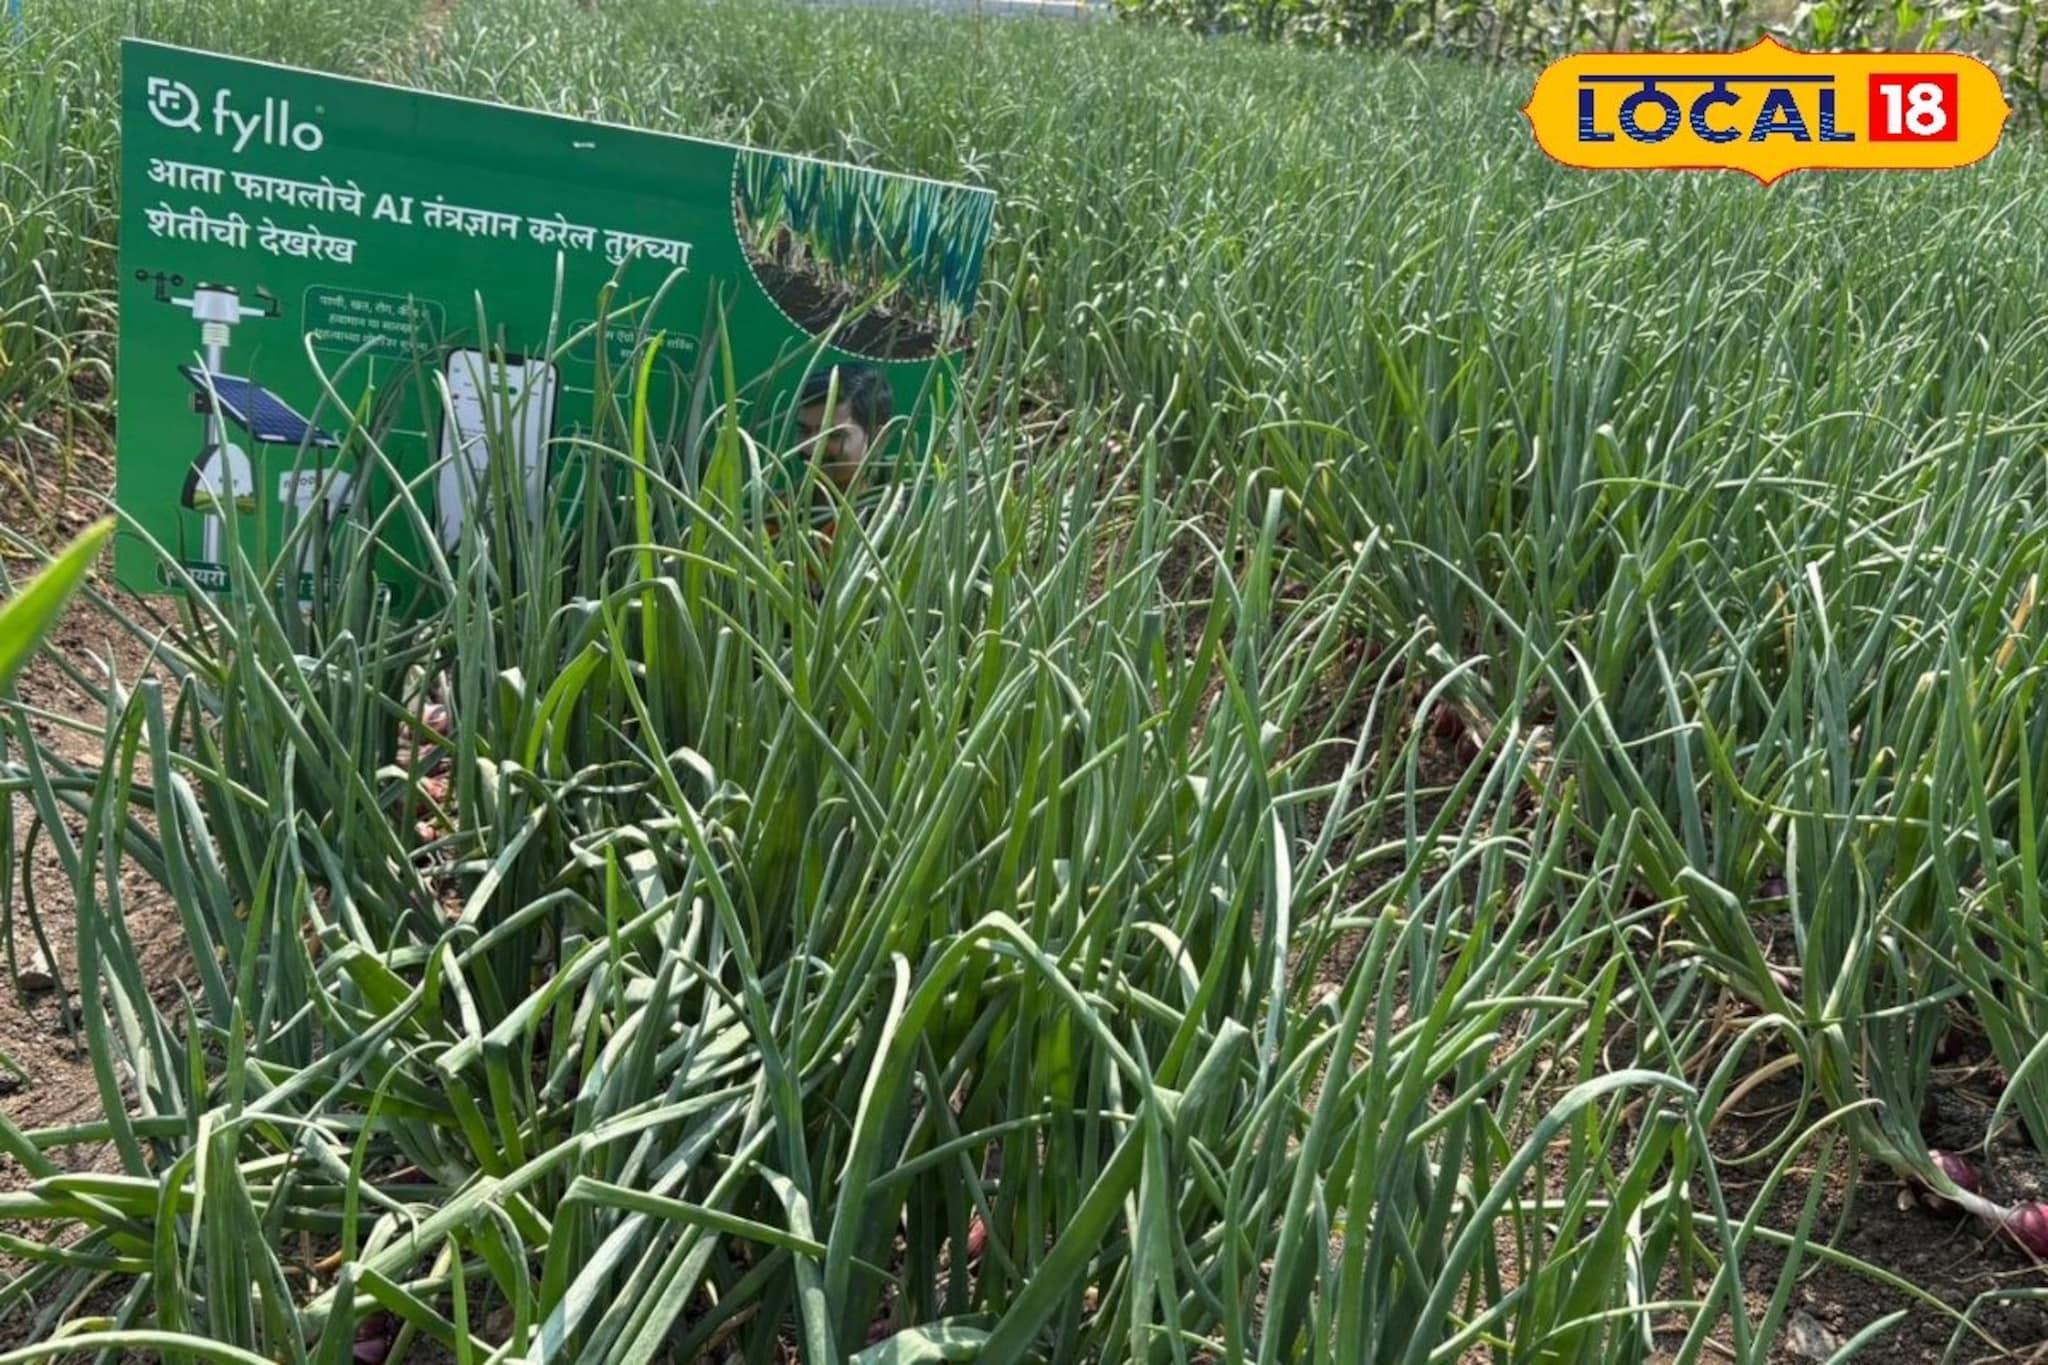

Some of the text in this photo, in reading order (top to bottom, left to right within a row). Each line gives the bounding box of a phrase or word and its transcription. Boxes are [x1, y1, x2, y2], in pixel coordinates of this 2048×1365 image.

[213, 89, 324, 153] fyllo
[144, 201, 357, 264] शेतीची देखरेख
[147, 157, 693, 265] आता फायलोचे AI तंत्रज्ञान करेल तुमच्या
